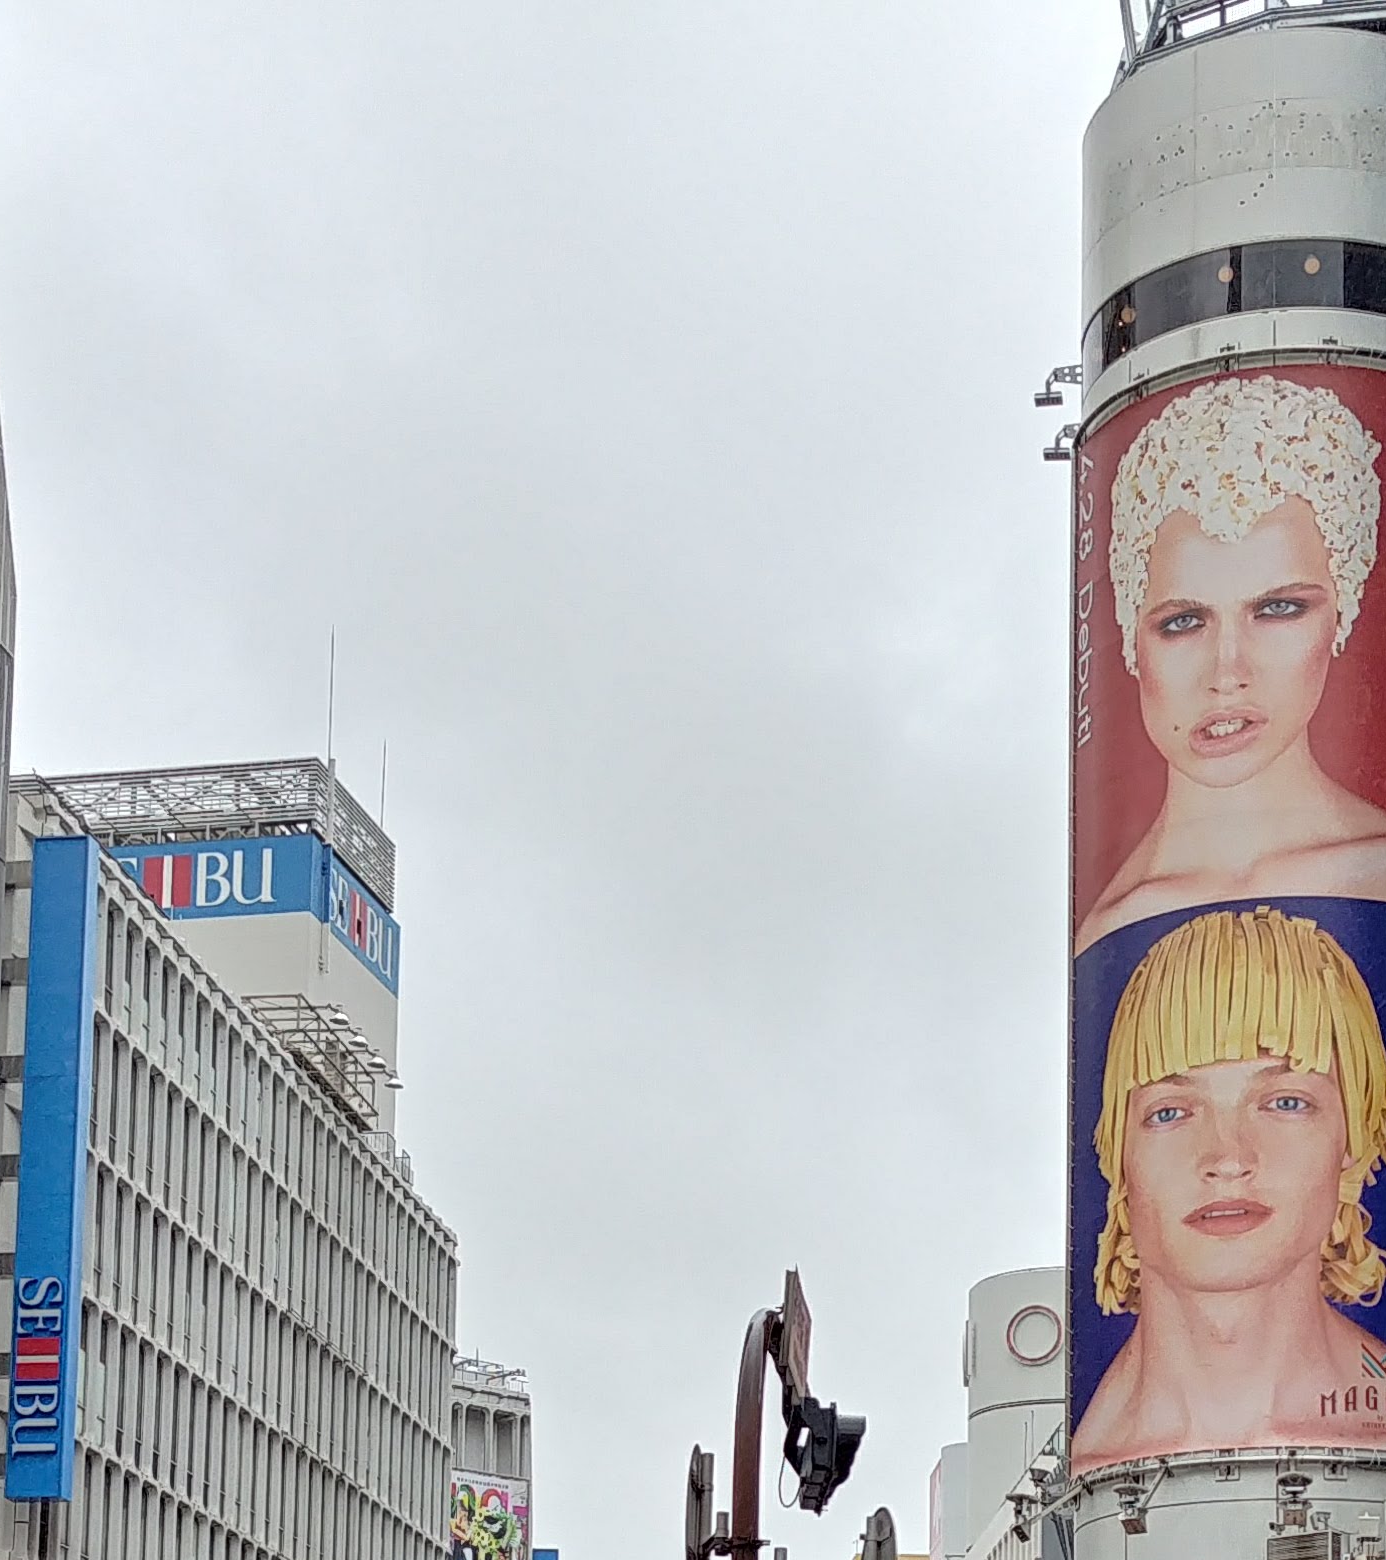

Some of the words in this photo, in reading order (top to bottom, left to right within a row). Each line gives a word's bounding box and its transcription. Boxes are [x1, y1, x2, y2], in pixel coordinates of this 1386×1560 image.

[1076, 582, 1095, 748] Debut!
[329, 869, 394, 981] SEIBU
[13, 1275, 64, 1457] SEIBU
